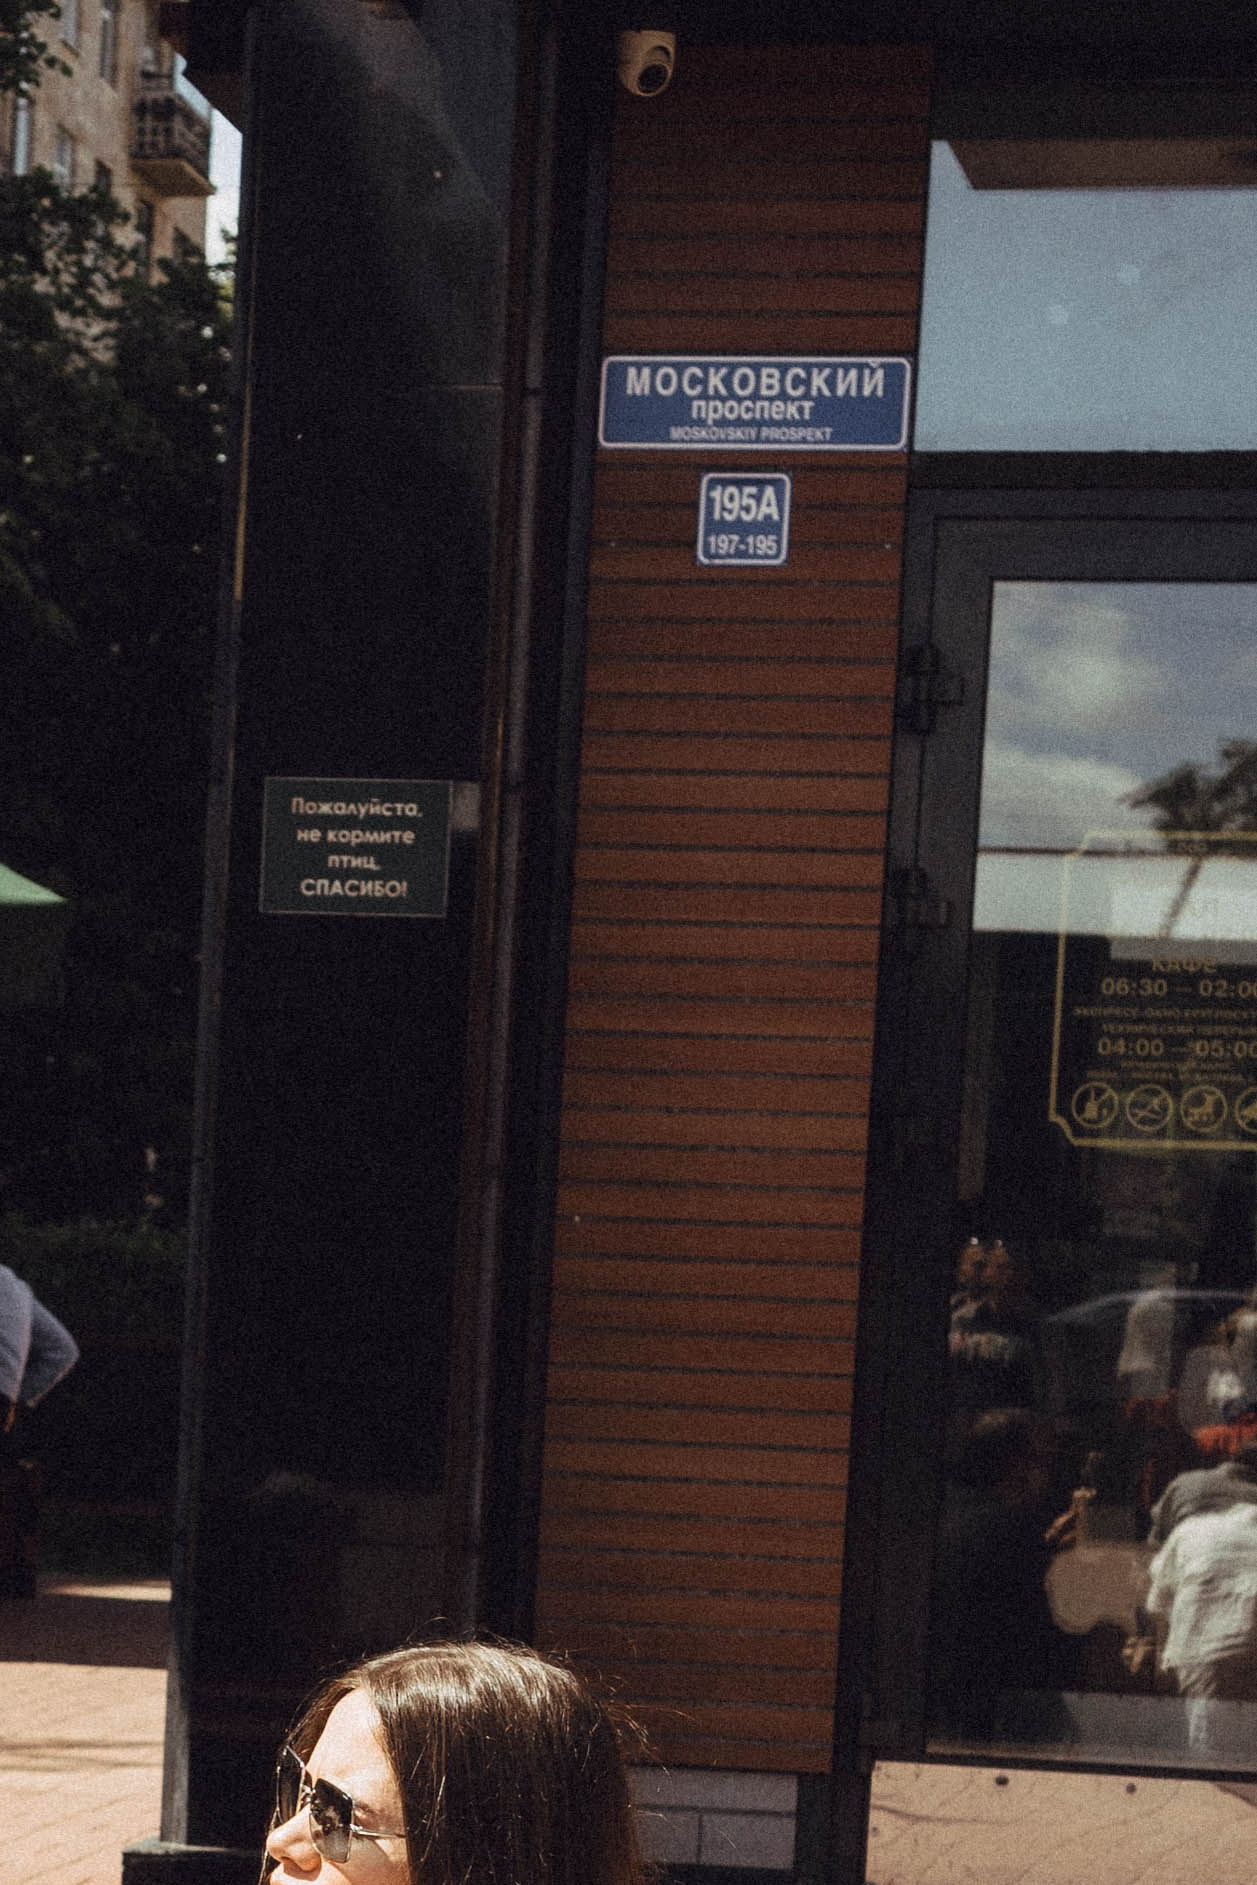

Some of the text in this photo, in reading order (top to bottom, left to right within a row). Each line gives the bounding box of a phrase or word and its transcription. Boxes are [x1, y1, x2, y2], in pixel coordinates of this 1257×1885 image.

[625, 360, 885, 399] МОСКОВСКИЙ
[690, 399, 815, 426] проспект
[760, 426, 833, 441] PROSPEKT
[709, 484, 780, 523] 195А
[707, 533, 778, 557] 197-195
[296, 829, 417, 848] не кормите
[300, 878, 408, 897] СПАСИБО!
[1100, 977, 1168, 998] 06:30
[1097, 1036, 1165, 1057] 04:00
